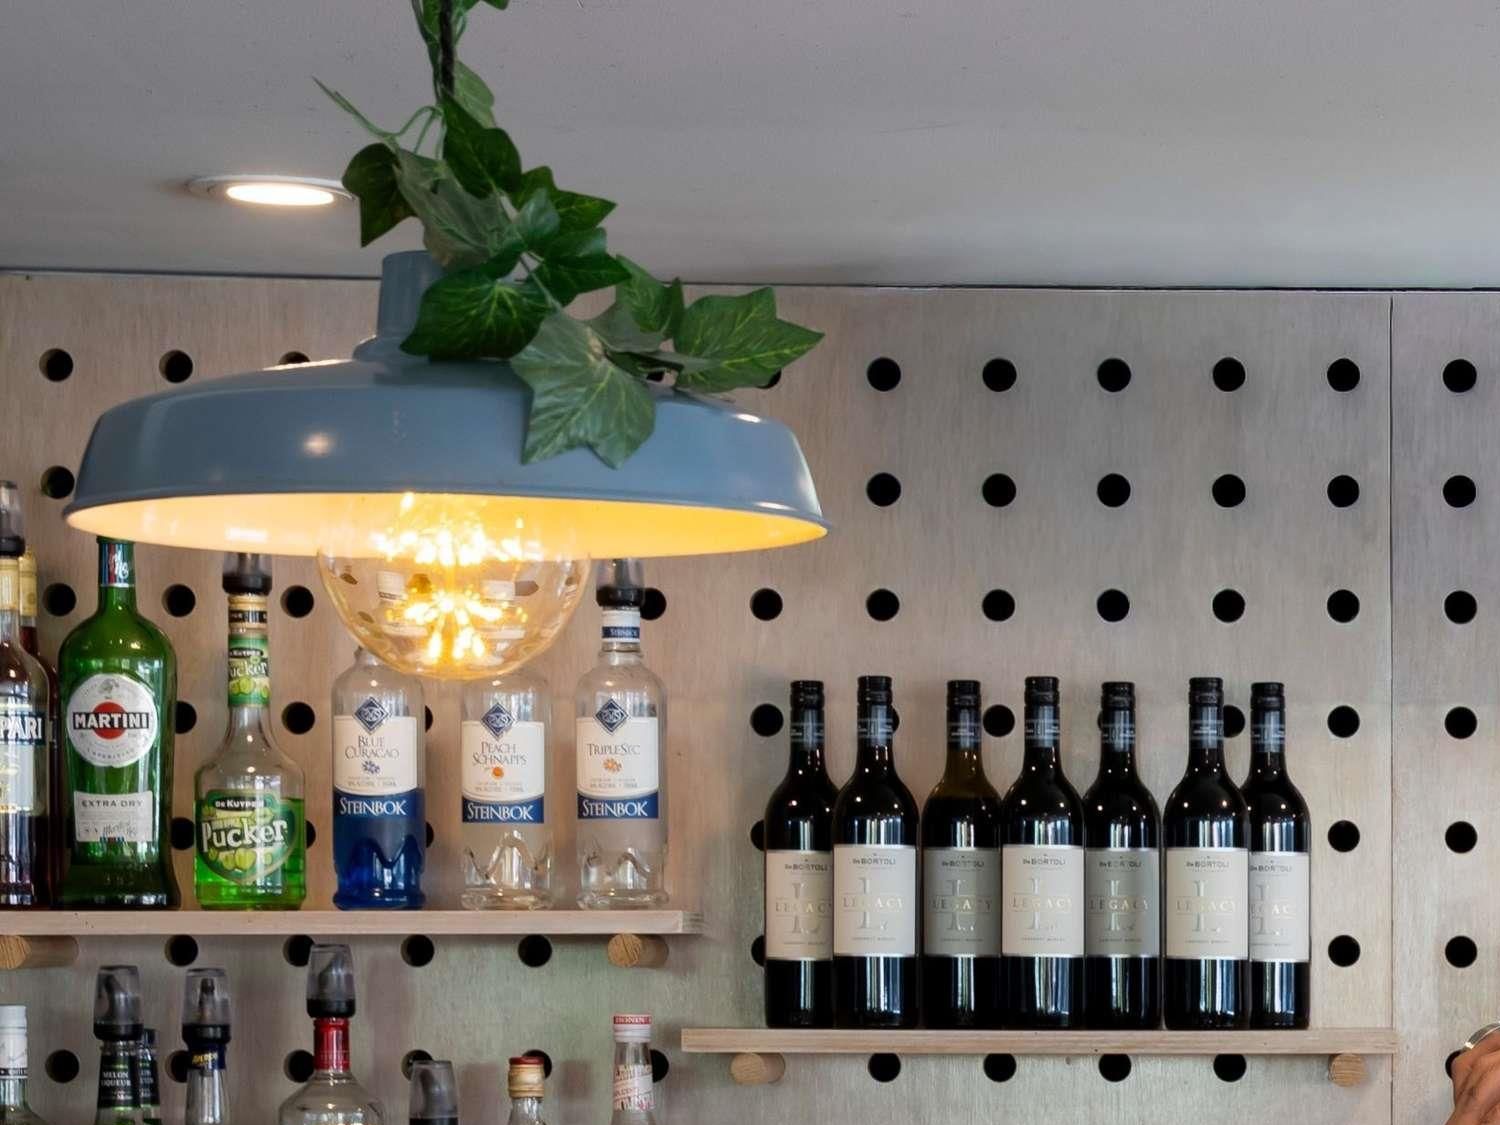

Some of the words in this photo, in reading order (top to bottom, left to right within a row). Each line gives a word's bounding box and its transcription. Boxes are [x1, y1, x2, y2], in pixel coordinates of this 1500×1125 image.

[74, 712, 149, 730] MARTINI
[81, 799, 117, 808] EXTRA
[121, 799, 143, 808] DRY
[339, 797, 407, 817] STEINBOK
[467, 802, 534, 823] STEINBOK
[582, 799, 648, 818] STEINBOK
[201, 818, 288, 853] Pucker
[101, 1079, 131, 1087] IQUEUR
